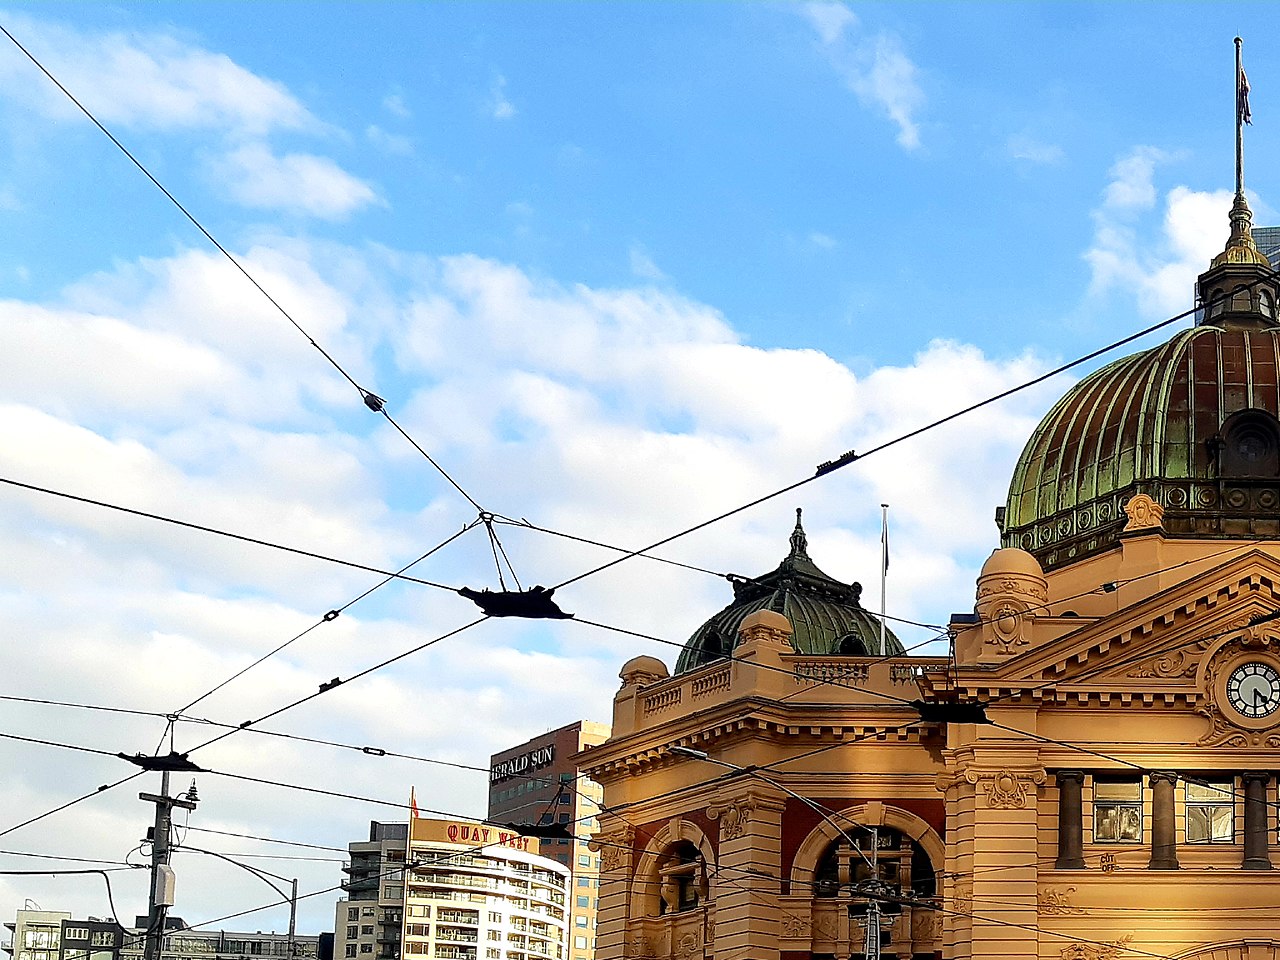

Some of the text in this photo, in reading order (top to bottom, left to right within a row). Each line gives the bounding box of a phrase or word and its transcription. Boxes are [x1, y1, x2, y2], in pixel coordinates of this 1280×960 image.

[531, 747, 553, 767] SUN
[447, 824, 529, 851] QUAY WEST
[1101, 855, 1114, 863] CUT
[1101, 864, 1115, 872] OFF
